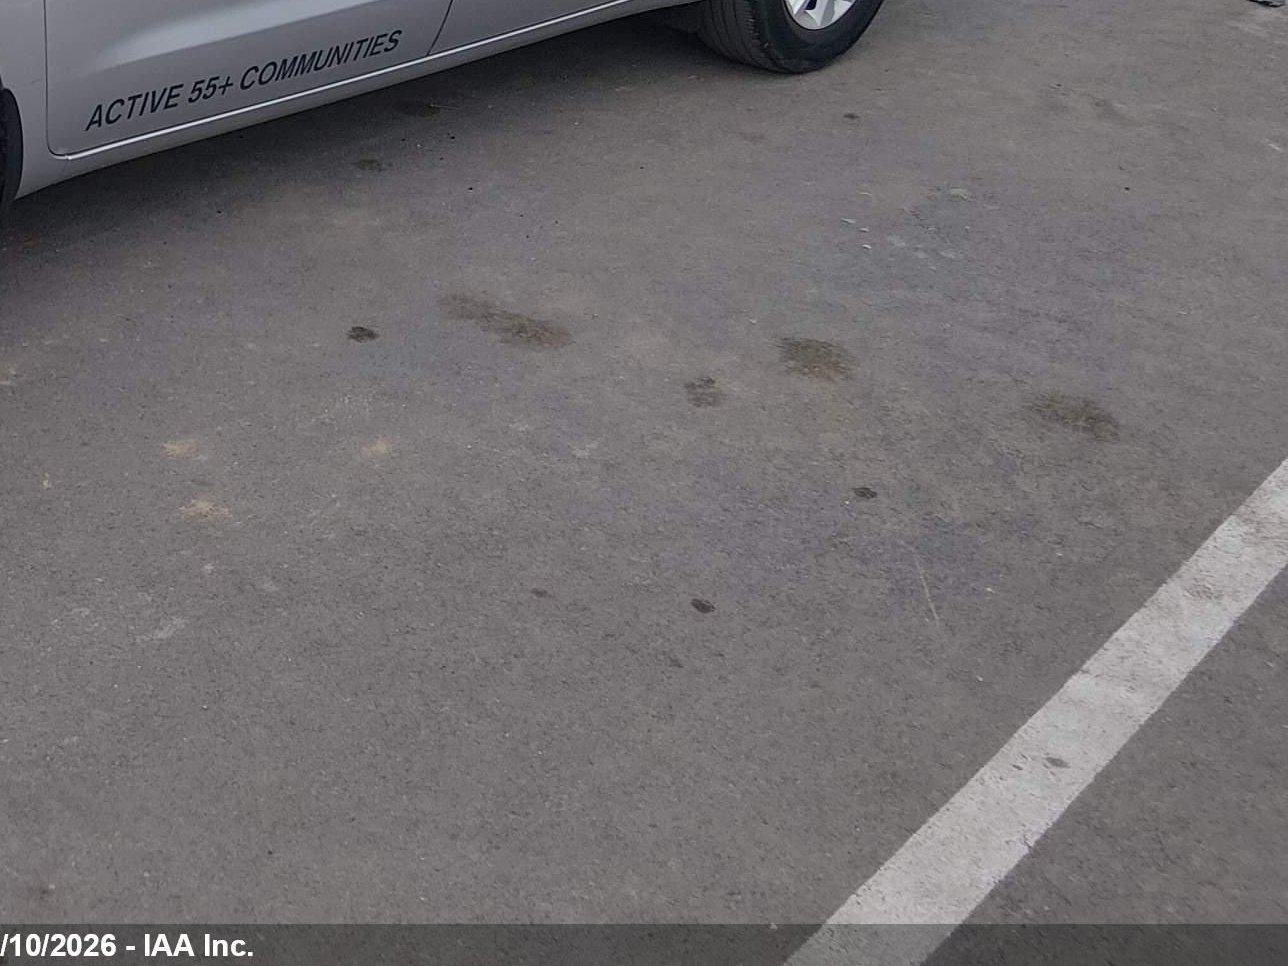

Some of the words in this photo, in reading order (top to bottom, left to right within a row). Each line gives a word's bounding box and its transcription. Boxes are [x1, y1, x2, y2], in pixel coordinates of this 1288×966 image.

[84, 83, 186, 132] ACTIVE
[187, 75, 234, 104] 55+
[239, 29, 404, 91] COMMUNITIES
